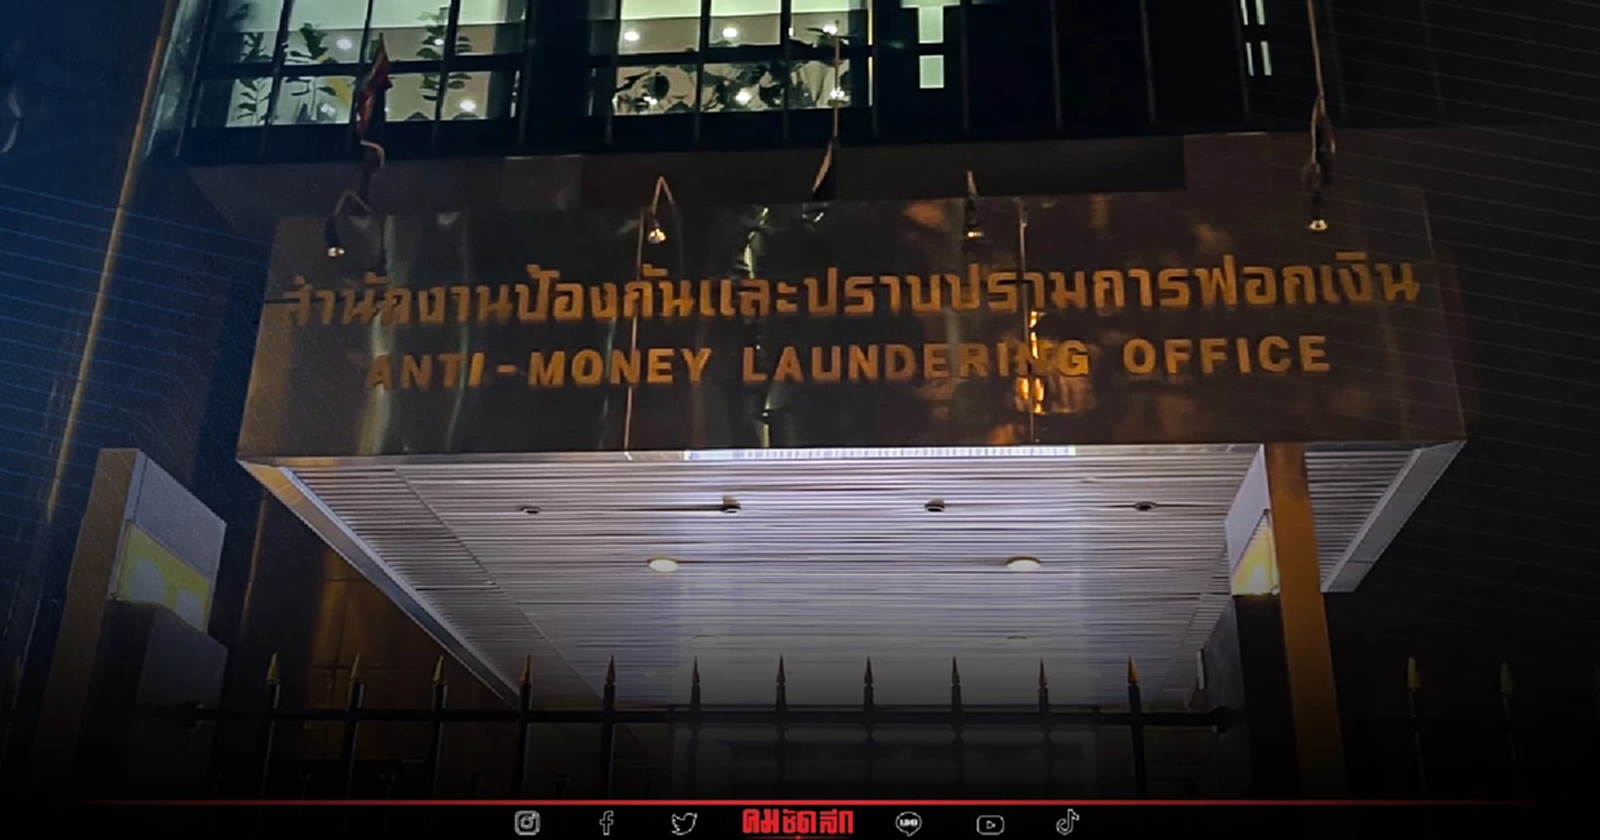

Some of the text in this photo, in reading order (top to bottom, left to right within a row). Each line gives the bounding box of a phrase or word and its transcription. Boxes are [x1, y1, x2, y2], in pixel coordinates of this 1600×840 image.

[281, 252, 1420, 326] สำนักงานป้องกันและปราบปรามการฟอกเงิน
[743, 339, 1089, 383] LAUNDERING
[1122, 335, 1330, 375] OFFICE
